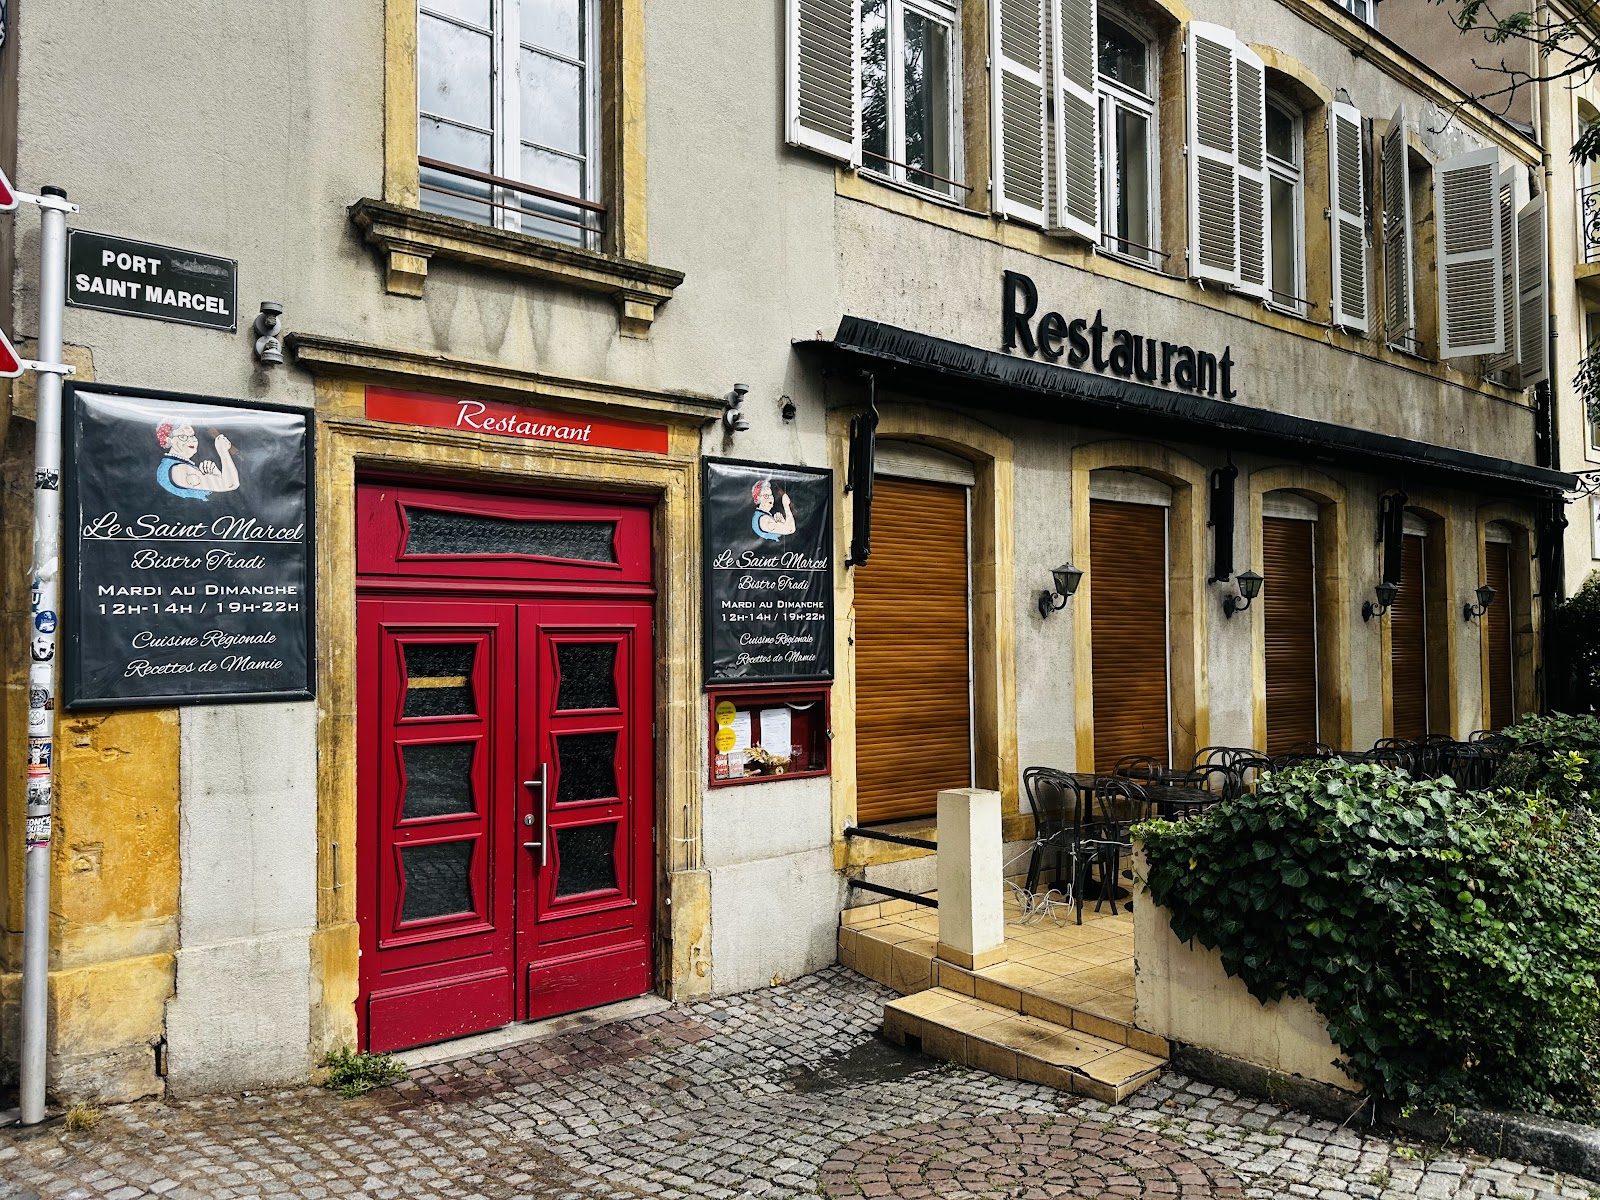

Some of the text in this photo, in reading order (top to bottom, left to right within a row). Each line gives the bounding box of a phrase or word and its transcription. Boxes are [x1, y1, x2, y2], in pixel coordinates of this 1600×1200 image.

[102, 250, 161, 275] PORT
[75, 273, 230, 315] SAINT MARCEL
[1002, 269, 1237, 401] Restaurant
[456, 400, 592, 442] Restaurant
[83, 511, 304, 541] Le Saint Marcel
[131, 549, 266, 571] Bistro Tradi
[713, 549, 828, 569] Le Saint Marcel
[98, 585, 162, 596] MARDI
[205, 584, 297, 596] DIMANCHE
[738, 575, 810, 591] Bistro Tradi
[777, 600, 824, 609] DIMANCHE
[132, 629, 277, 650] Cuisine Régionale
[740, 632, 775, 645] Cuisine
[124, 655, 283, 678] Recettes de Mamie
